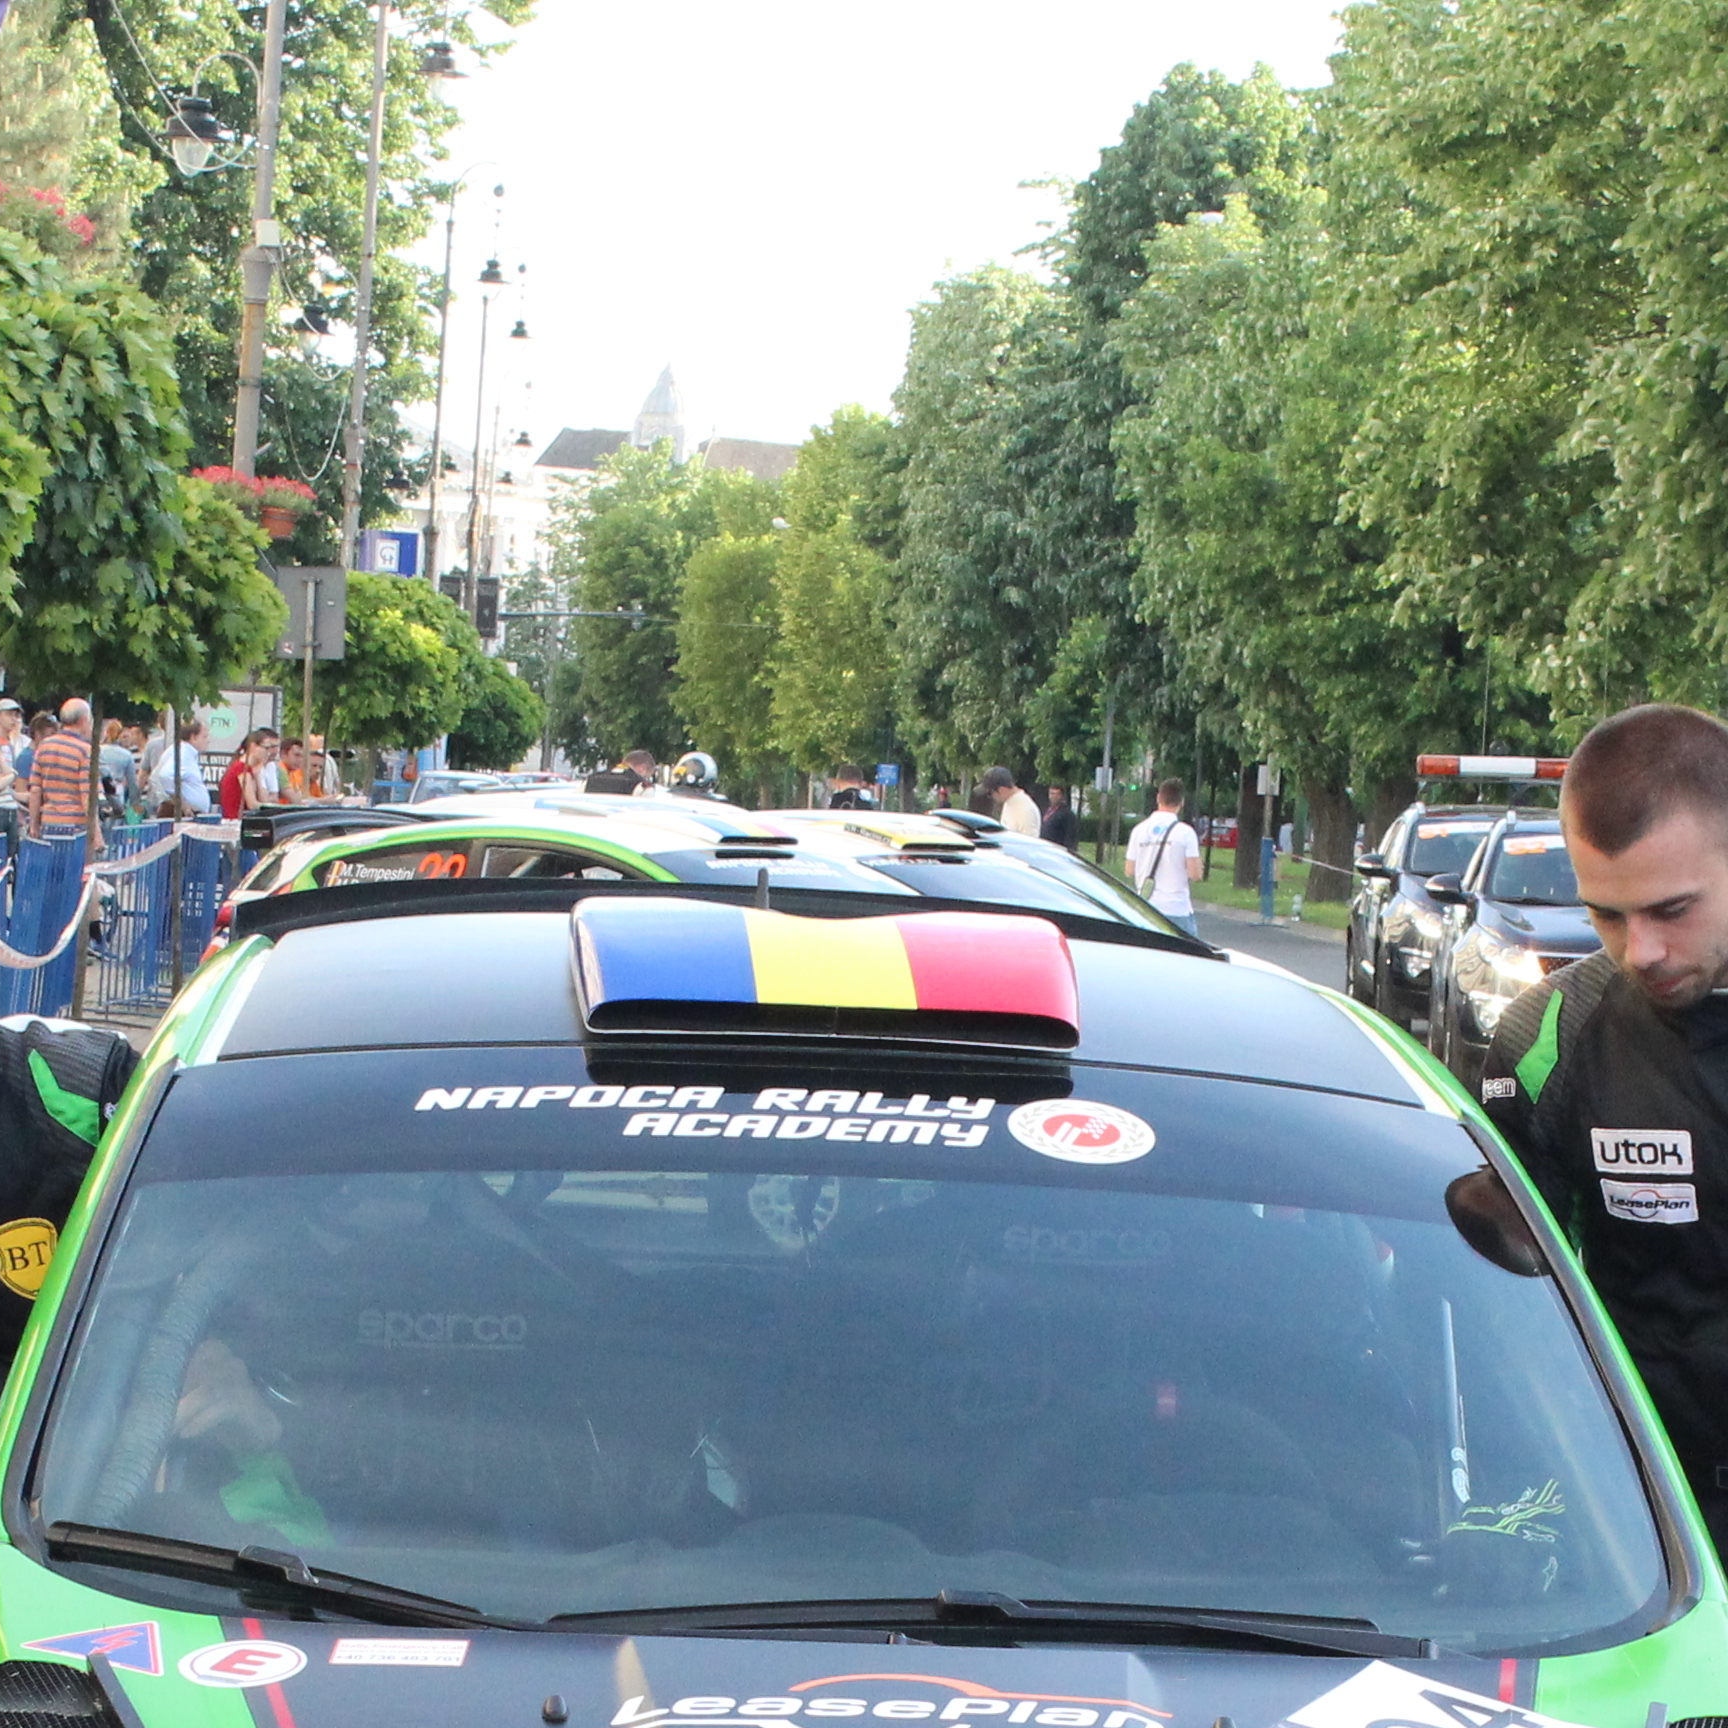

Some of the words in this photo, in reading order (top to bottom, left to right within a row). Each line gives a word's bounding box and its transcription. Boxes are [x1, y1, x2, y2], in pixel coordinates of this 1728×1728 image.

[415, 1085, 726, 1112] NAPOCA
[753, 1087, 995, 1121] RALLY
[623, 1112, 992, 1149] ACADEMY
[1608, 1194, 1690, 1213] LeasePlan
[9, 1240, 50, 1270] BT
[358, 1308, 528, 1342] sparco
[210, 1649, 271, 1677] E
